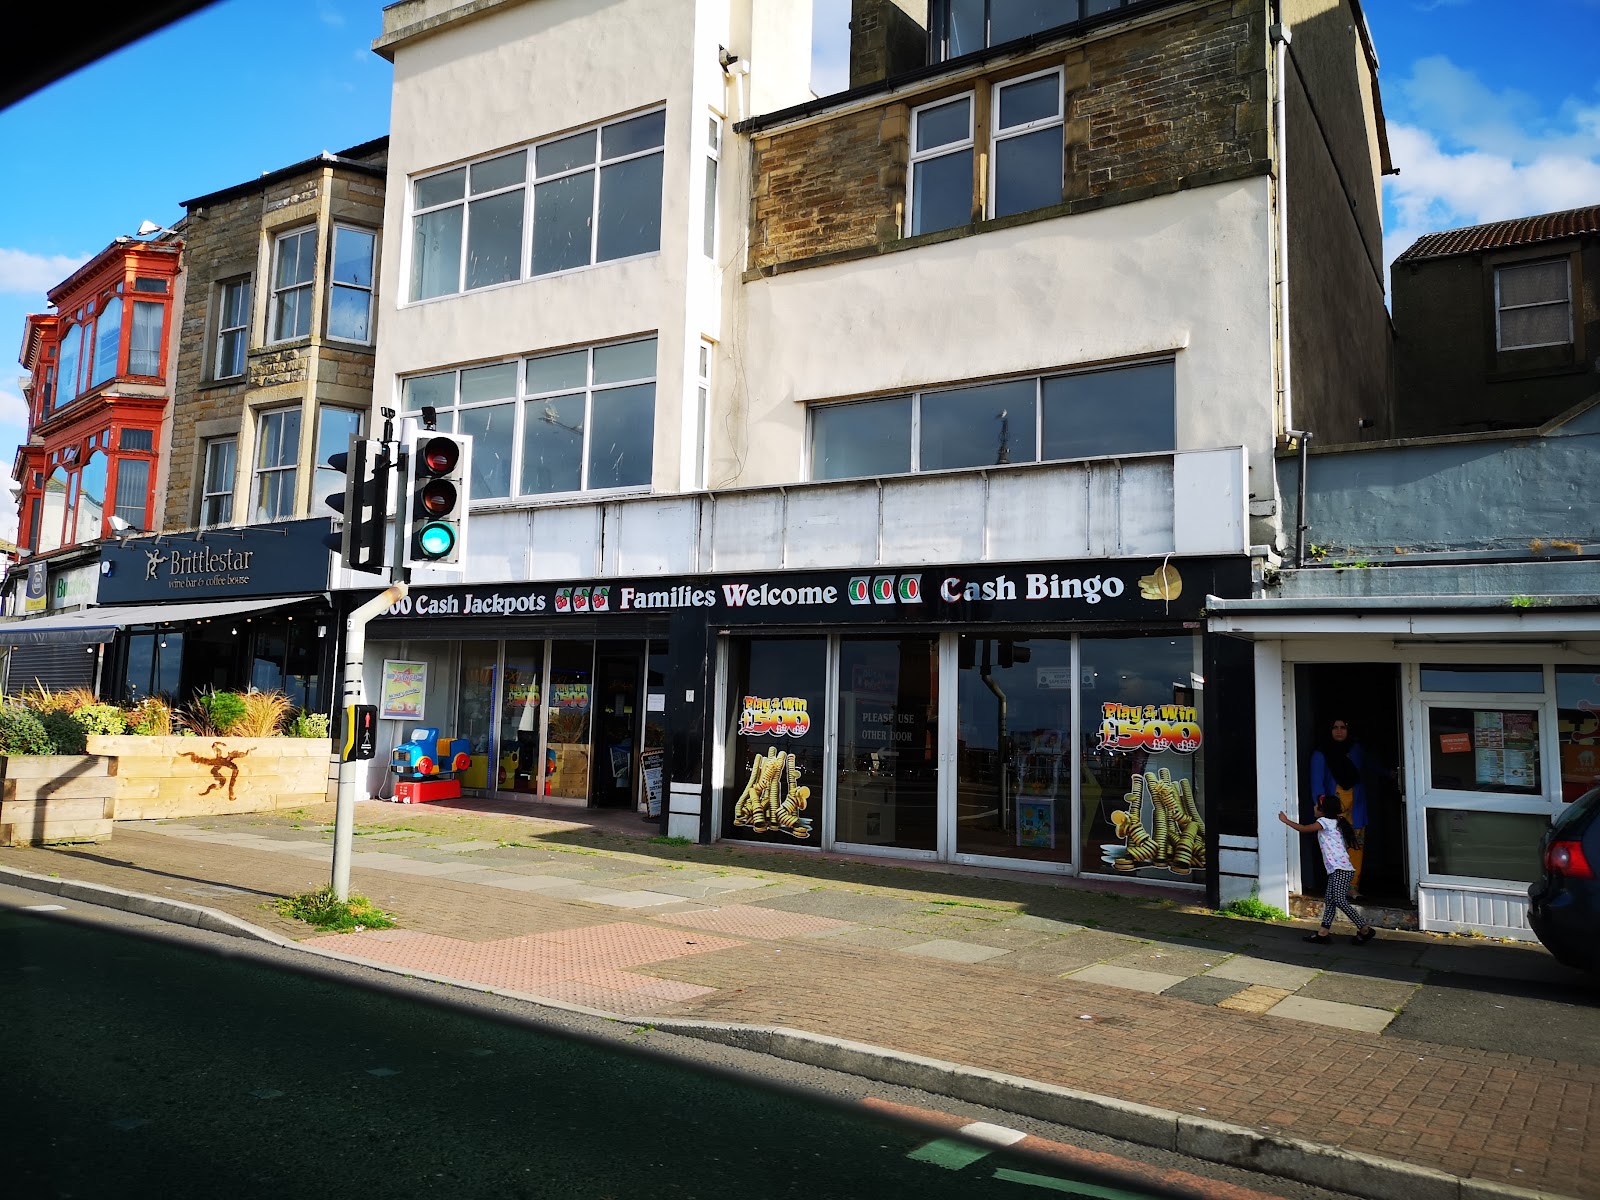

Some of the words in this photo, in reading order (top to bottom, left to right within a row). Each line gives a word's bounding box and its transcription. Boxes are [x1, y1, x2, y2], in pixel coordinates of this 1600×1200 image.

[170, 546, 254, 575] Brittlestar
[168, 578, 184, 588] wine
[186, 576, 196, 588] bar
[197, 577, 204, 587] &
[206, 575, 226, 586] coffee
[226, 574, 250, 585] house
[415, 594, 459, 615] Cash
[463, 592, 547, 616] Jackpots
[620, 585, 716, 610] Families
[721, 582, 838, 608] Welcome
[940, 574, 1018, 605] Cash
[1026, 573, 1126, 606] Bingo
[744, 696, 770, 712] Play
[771, 698, 780, 710] &
[782, 697, 808, 711] Win
[1102, 702, 1142, 725] Play
[1142, 704, 1158, 720] &
[1159, 704, 1198, 721] Win
[738, 711, 811, 738] £500
[862, 712, 894, 724] PLEASE
[897, 714, 915, 724] USE
[862, 730, 887, 740] OTHER
[890, 731, 913, 742] DOOR
[1096, 720, 1203, 756] £500
